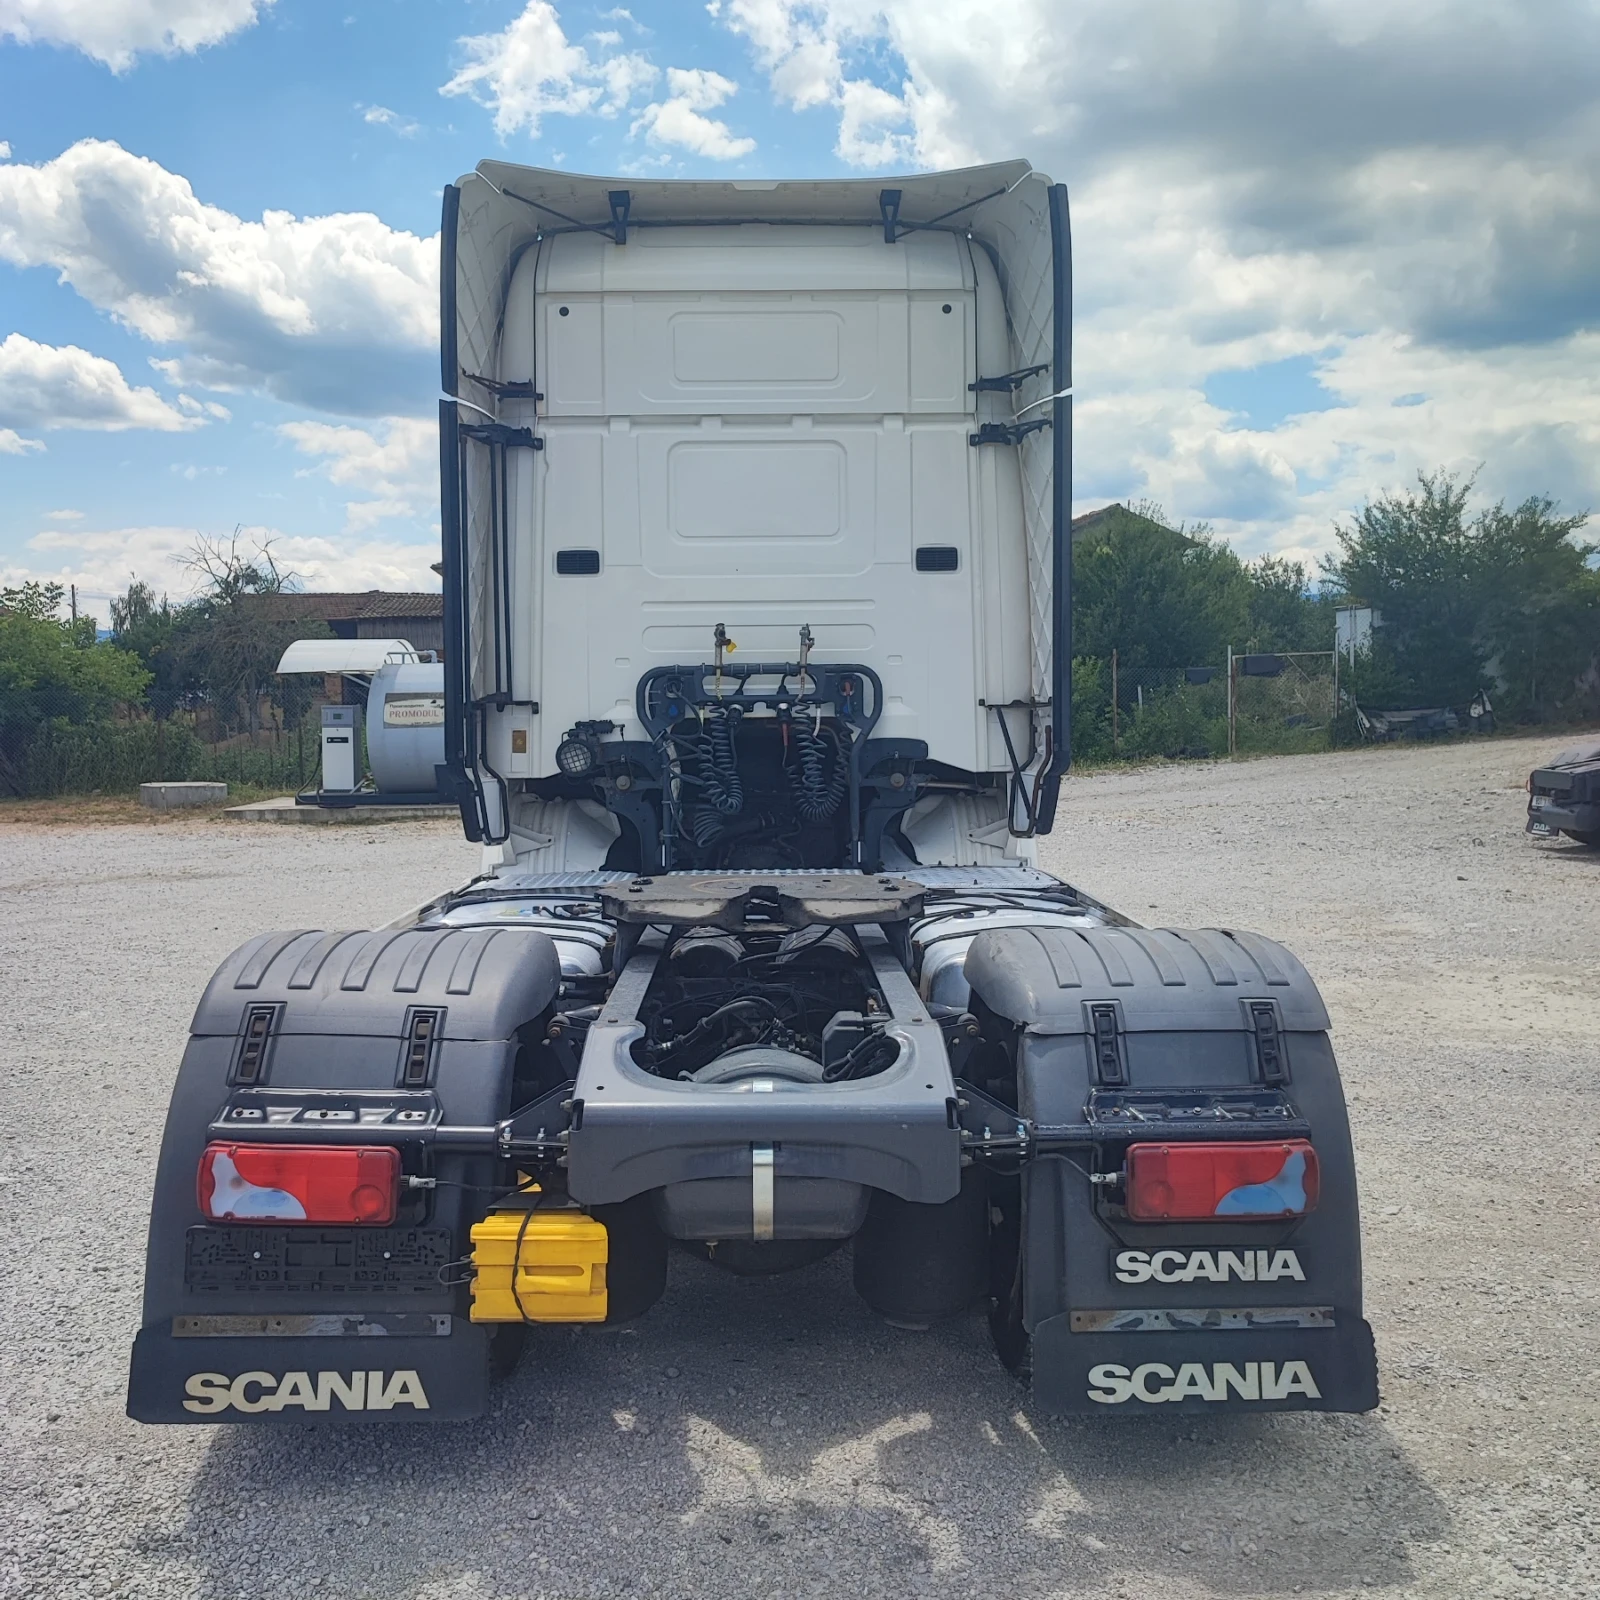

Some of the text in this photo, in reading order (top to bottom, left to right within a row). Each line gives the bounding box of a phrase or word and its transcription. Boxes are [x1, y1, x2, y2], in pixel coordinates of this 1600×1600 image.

[389, 709, 440, 718] PROMODUL
[1115, 1250, 1306, 1283] SCANIA
[182, 1370, 430, 1413] SCANIA
[1087, 1360, 1323, 1404] SCANIA
